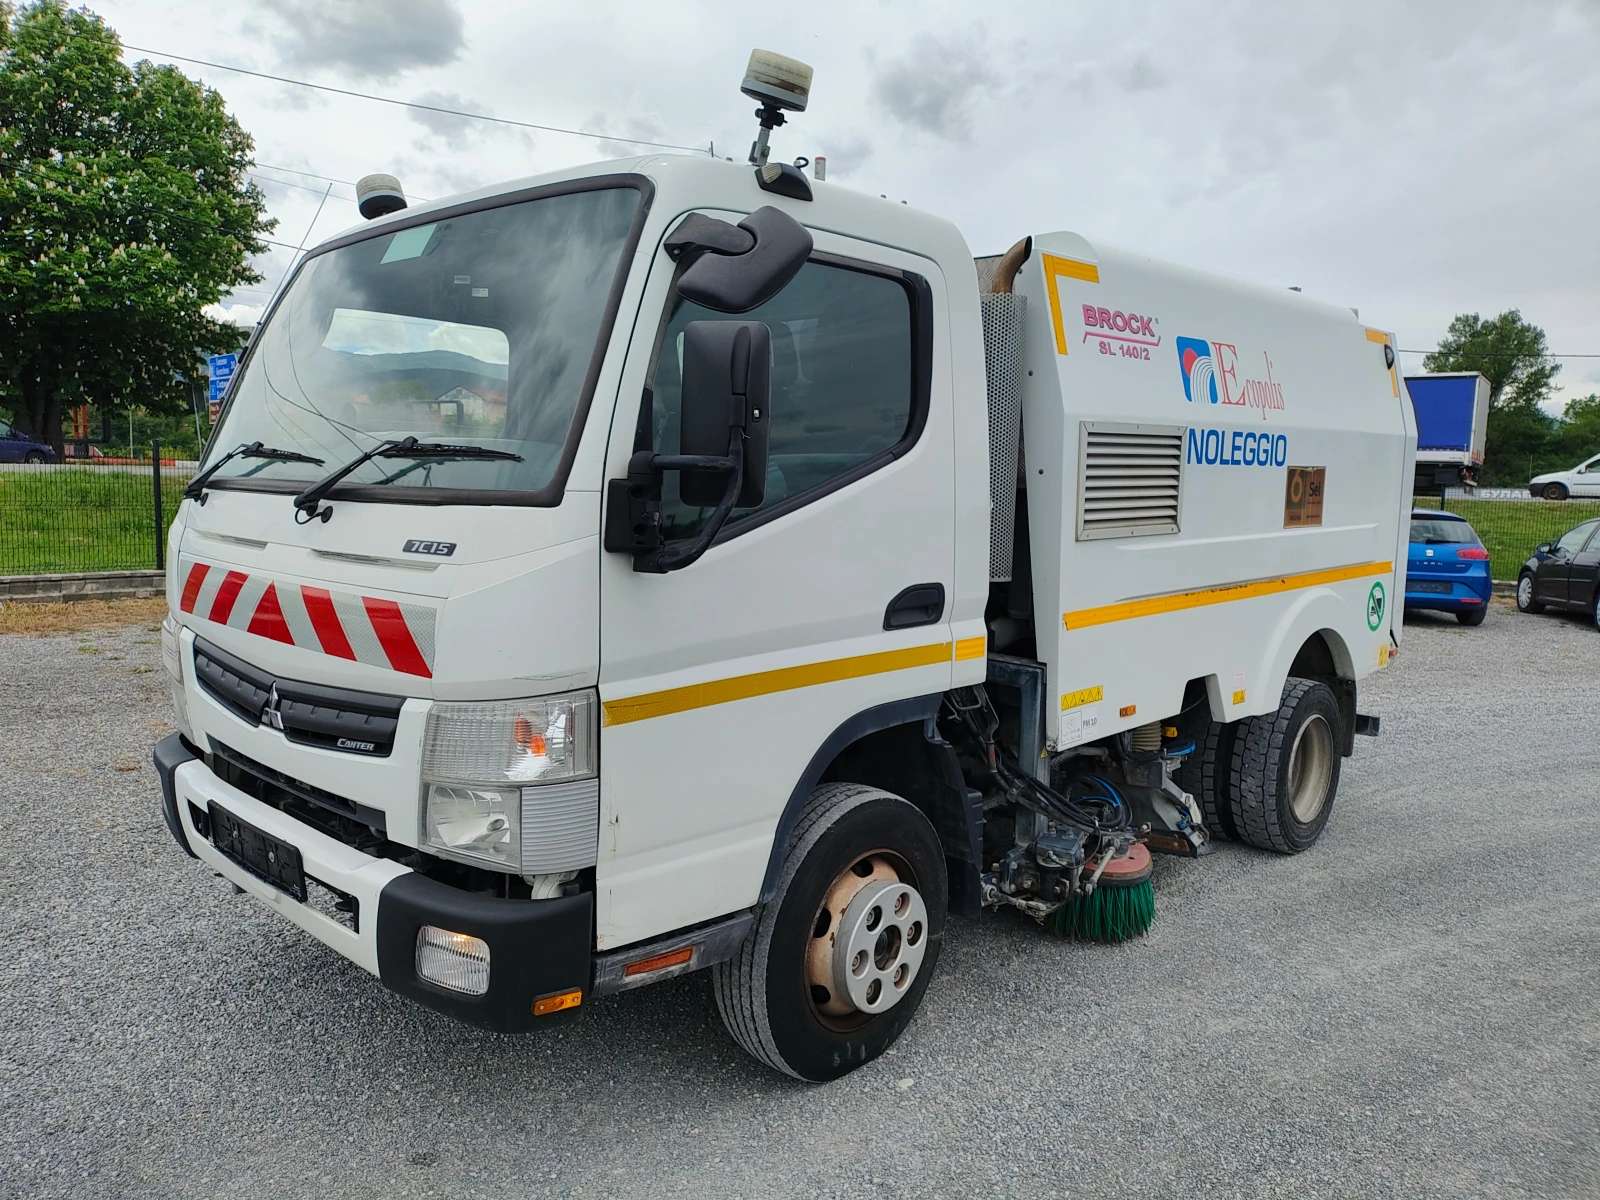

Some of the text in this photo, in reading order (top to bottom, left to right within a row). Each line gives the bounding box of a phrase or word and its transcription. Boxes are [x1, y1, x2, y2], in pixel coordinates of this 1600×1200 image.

[1082, 304, 1155, 337] BROCK
[1099, 341, 1150, 360] SL 140/2
[1211, 341, 1284, 420] Ecopolis
[1187, 428, 1287, 467] NOLEGGIO
[410, 541, 451, 554] 7C15
[1091, 717, 1097, 726] 10
[336, 738, 375, 751] CANTER
